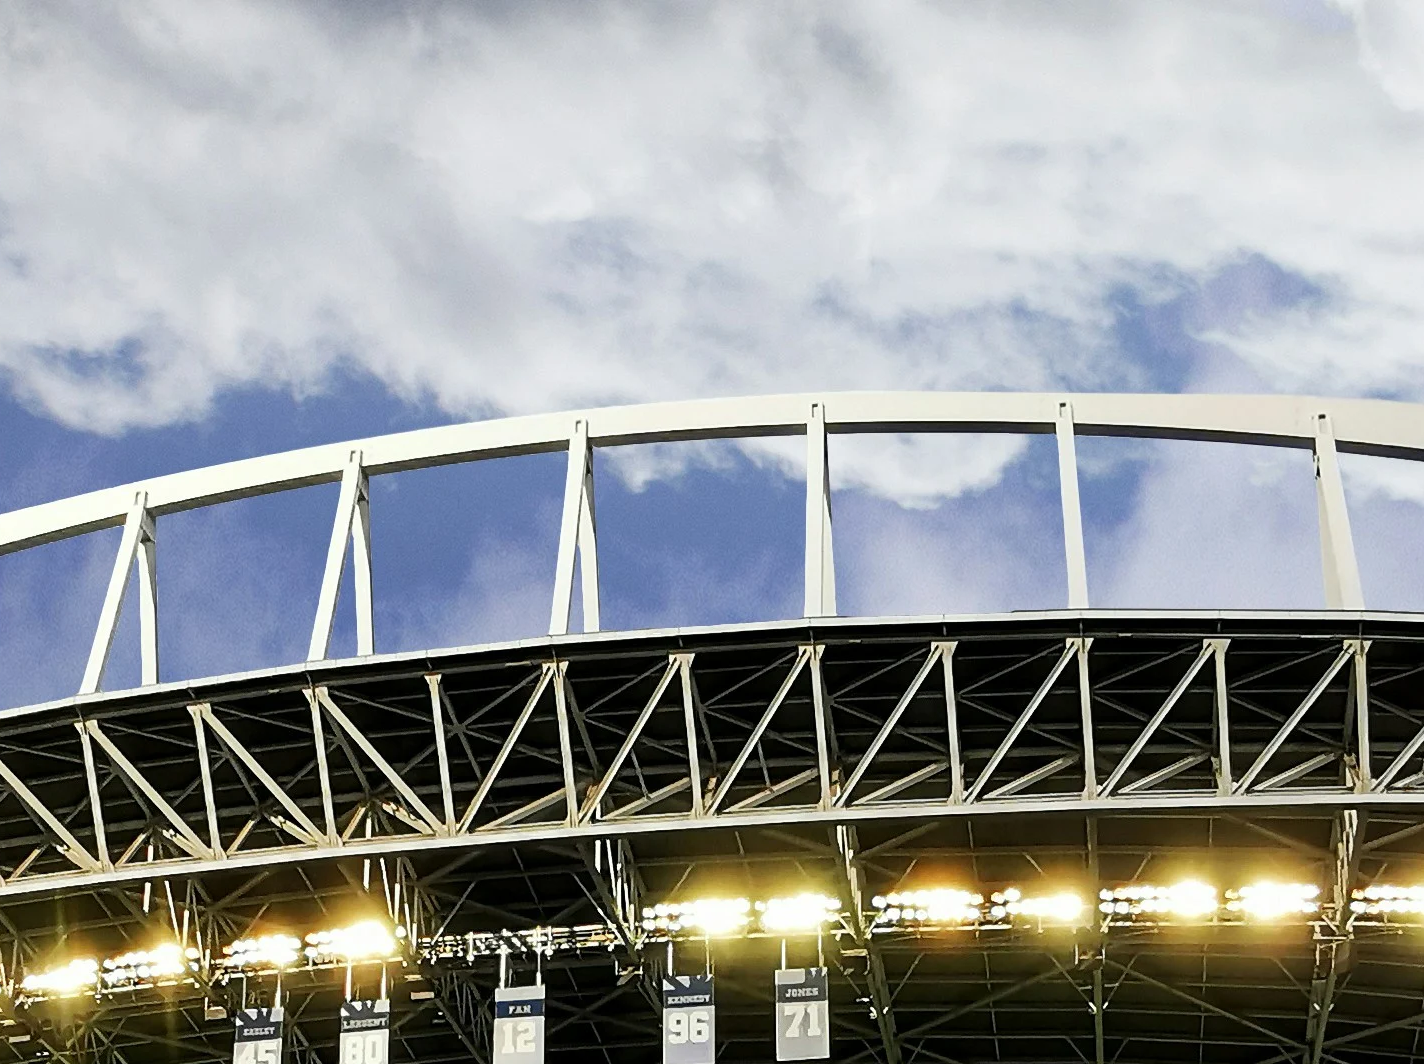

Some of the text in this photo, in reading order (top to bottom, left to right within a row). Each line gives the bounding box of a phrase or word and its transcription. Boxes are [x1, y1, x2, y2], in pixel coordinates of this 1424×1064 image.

[786, 988, 818, 997] JONES
[509, 1005, 531, 1014] FAN
[784, 1003, 821, 1037] 71
[501, 1022, 536, 1054] 12
[668, 1011, 709, 1044] 96
